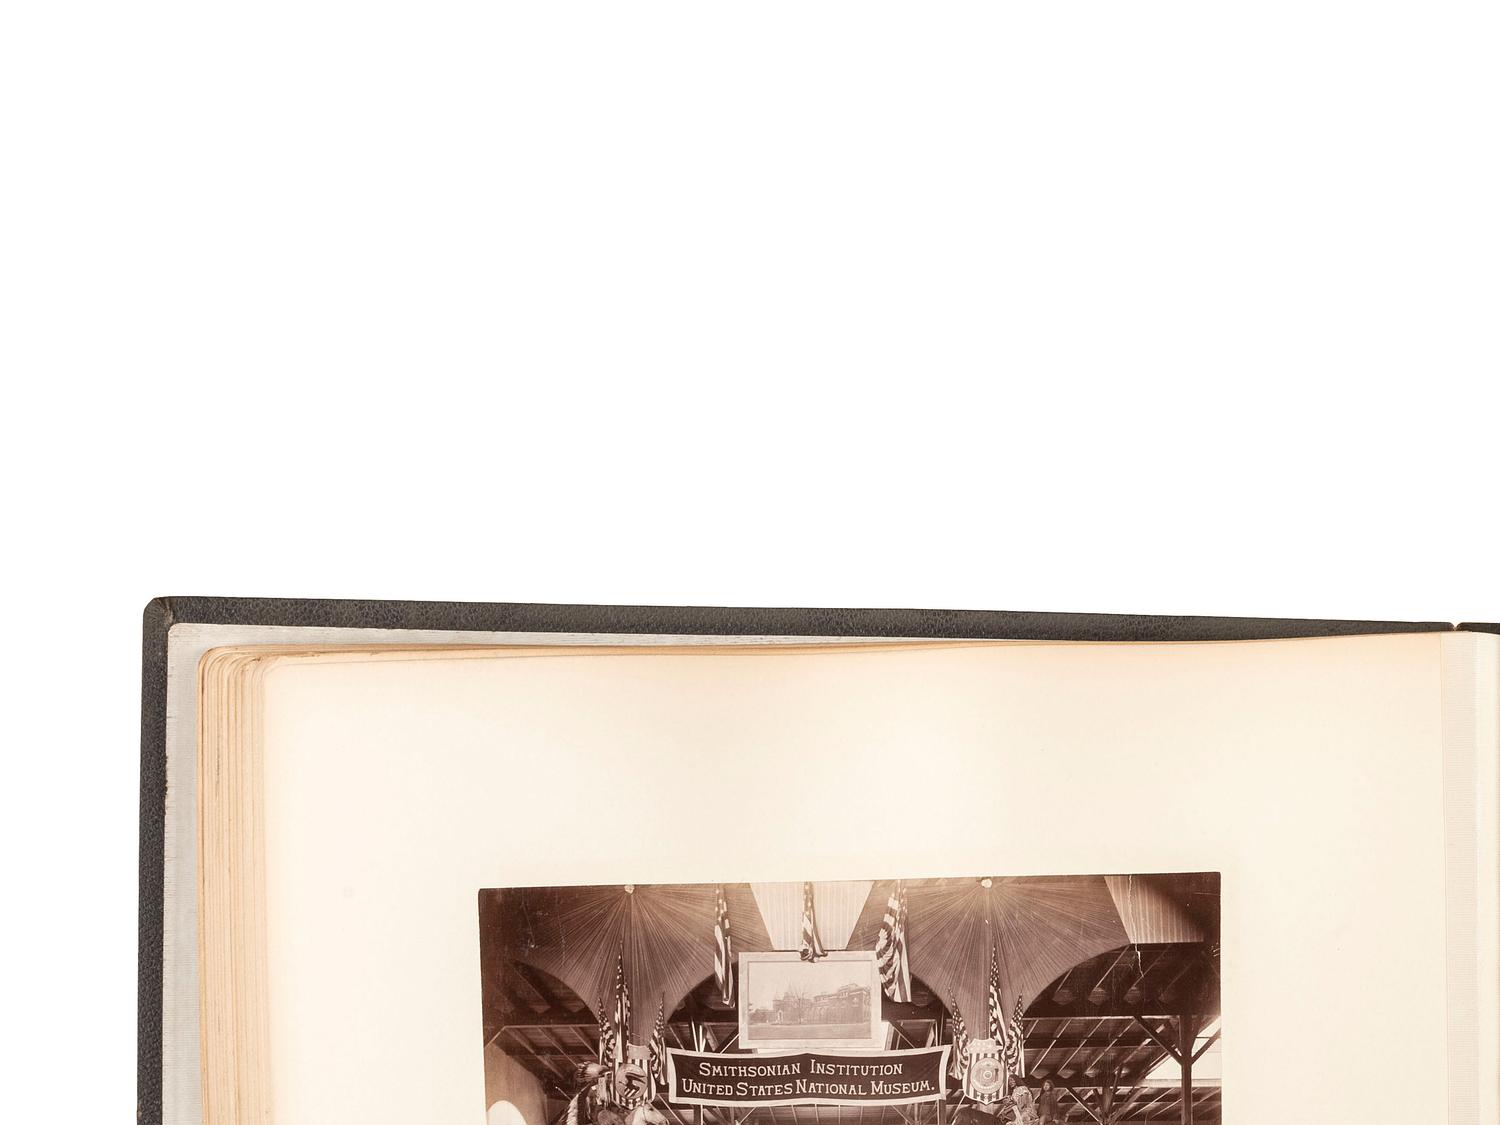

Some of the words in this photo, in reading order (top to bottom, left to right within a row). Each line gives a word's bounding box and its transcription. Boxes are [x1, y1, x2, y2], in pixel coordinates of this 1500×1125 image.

[699, 1062, 801, 1077] SMITHSONIAN
[810, 1059, 903, 1075] INSTITUTION
[682, 1078, 733, 1096] UNITED
[736, 1081, 794, 1096] STATES
[796, 1079, 867, 1095] NATIONAL
[870, 1080, 935, 1095] MUSEUM.
